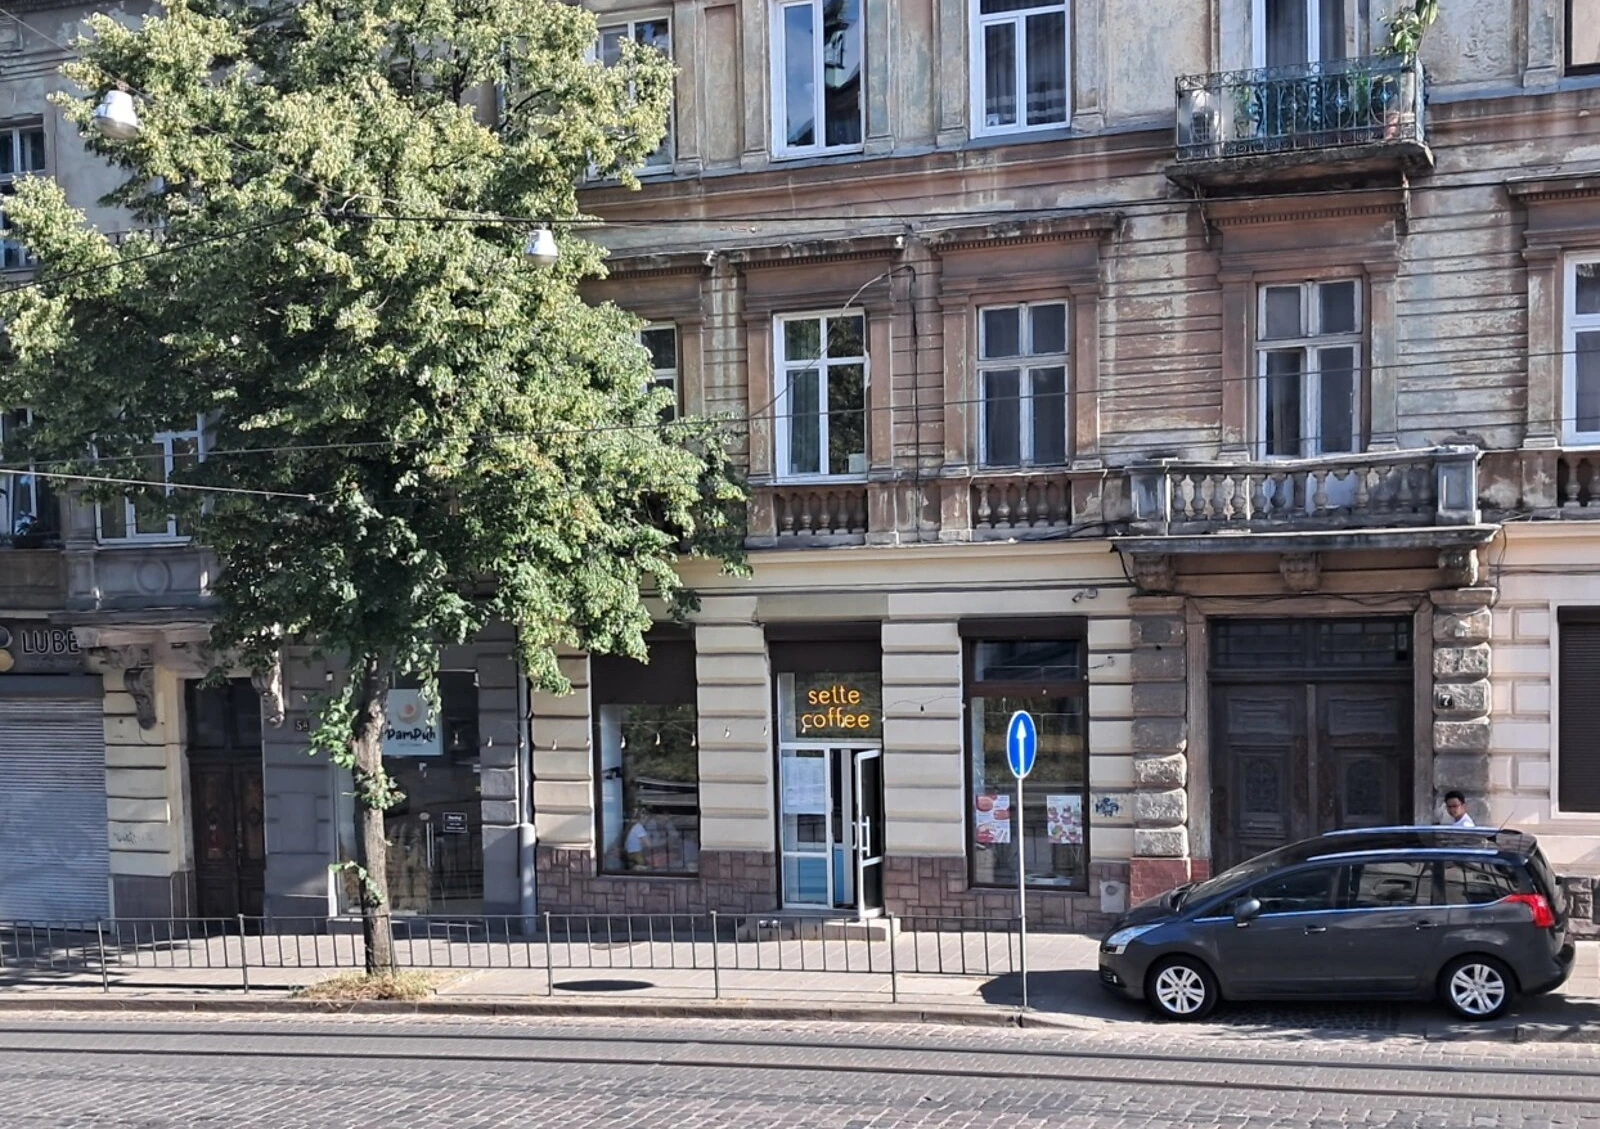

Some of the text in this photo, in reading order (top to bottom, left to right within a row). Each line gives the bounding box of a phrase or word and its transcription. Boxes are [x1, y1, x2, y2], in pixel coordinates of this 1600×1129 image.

[808, 685, 860, 705] sette
[1442, 694, 1451, 706] 7
[801, 706, 871, 728] coffee
